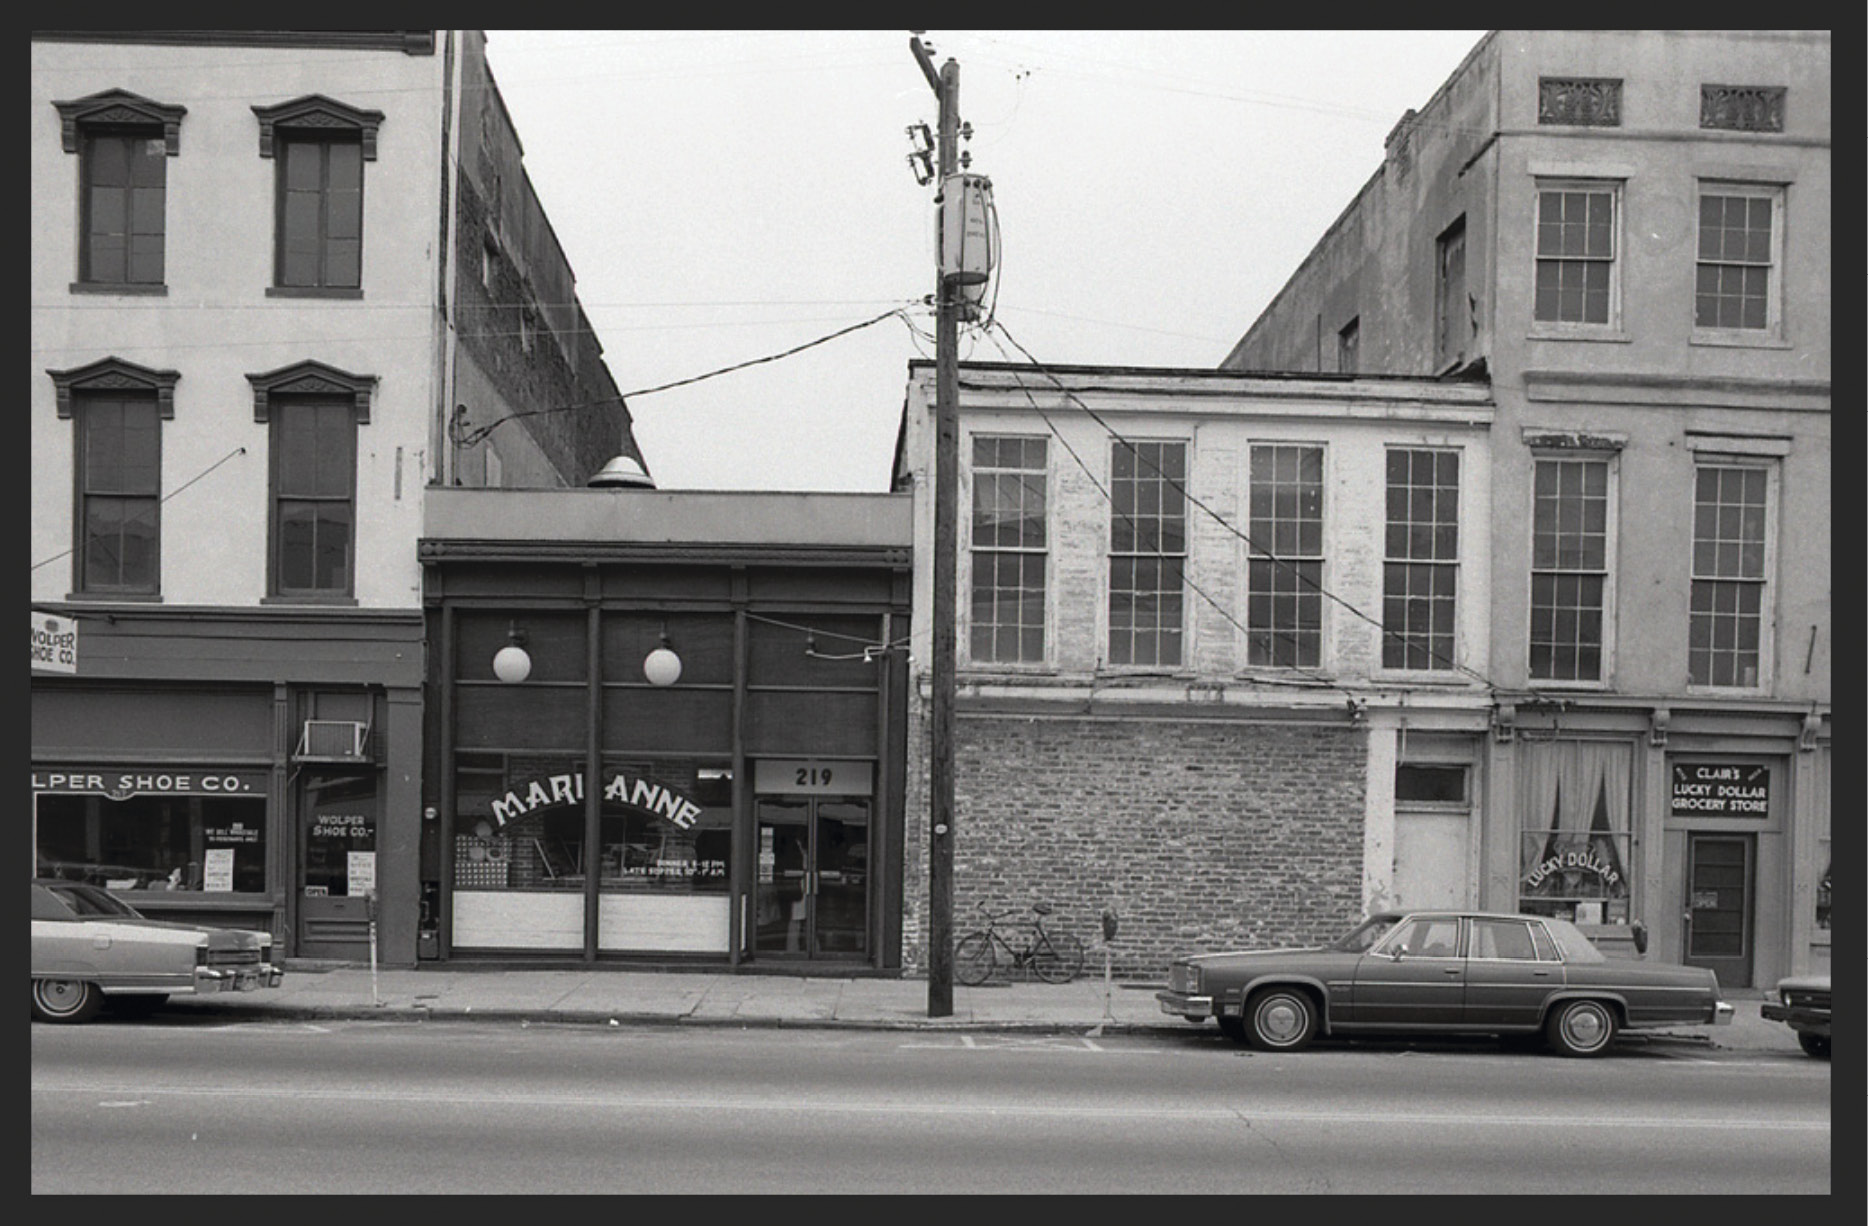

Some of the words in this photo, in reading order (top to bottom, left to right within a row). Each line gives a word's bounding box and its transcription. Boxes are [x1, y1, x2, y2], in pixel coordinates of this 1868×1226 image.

[796, 768, 832, 785] 219
[1696, 767, 1740, 780] CLAIR'S
[31, 774, 105, 789] LPER
[118, 775, 191, 790] SHOE
[201, 775, 249, 791] CO.
[1674, 783, 1711, 796] LUCKY
[1717, 785, 1766, 798] DOLLAR
[1672, 798, 1727, 810] GROCERY
[1729, 800, 1768, 812] STORE
[317, 814, 365, 825] WOLPER
[313, 825, 347, 837] SHOE
[1528, 853, 1564, 887] LUCKY
[1567, 851, 1619, 886] DOLLAR
